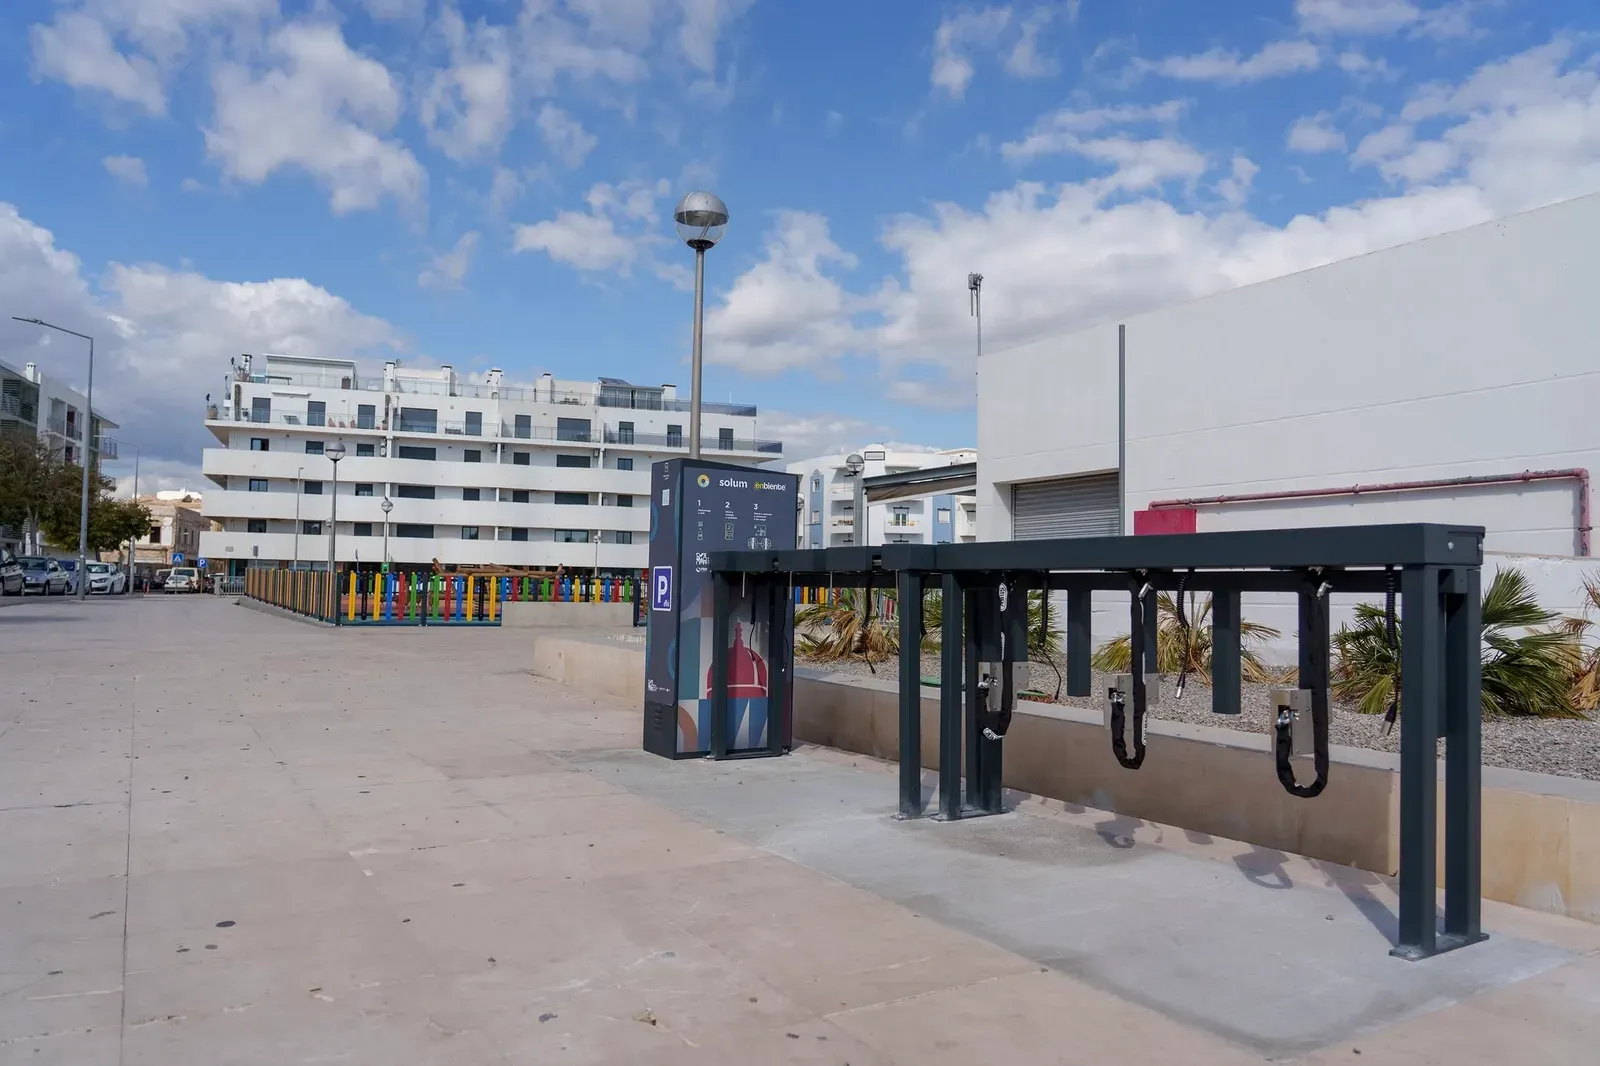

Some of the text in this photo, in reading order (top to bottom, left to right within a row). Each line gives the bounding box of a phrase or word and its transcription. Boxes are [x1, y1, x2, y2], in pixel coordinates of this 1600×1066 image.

[719, 478, 748, 488] solum
[697, 499, 701, 507] 1
[199, 559, 205, 567] P
[658, 575, 668, 603] P
